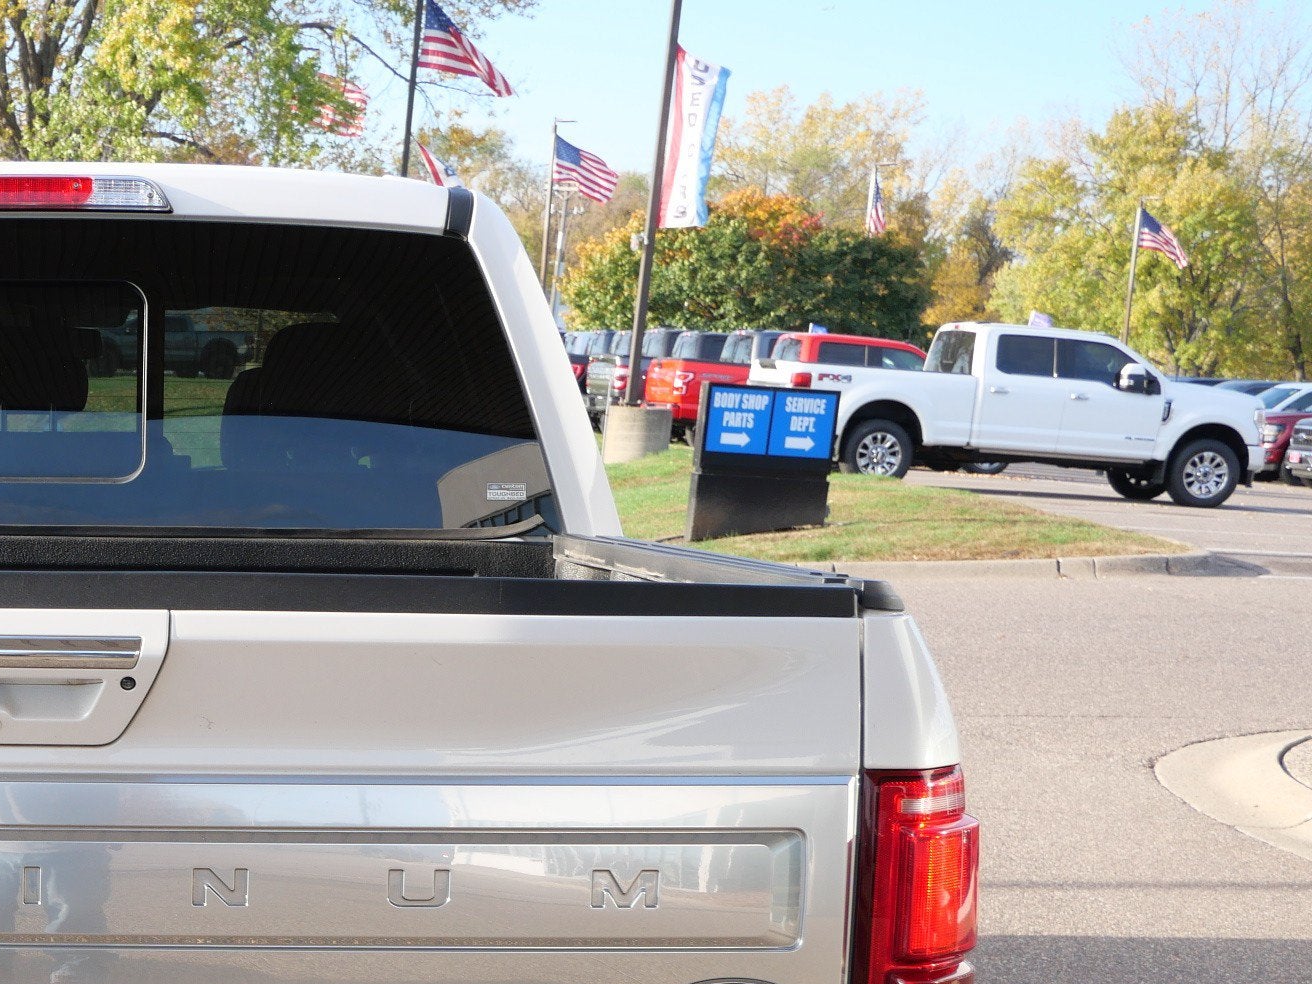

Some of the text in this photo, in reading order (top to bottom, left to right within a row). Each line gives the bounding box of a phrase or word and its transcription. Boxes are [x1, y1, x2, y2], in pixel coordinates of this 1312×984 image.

[713, 392, 770, 411] BODY SHOP
[785, 396, 827, 415] SERVICE
[722, 411, 755, 429] PARTS
[789, 416, 816, 433] DEPT.
